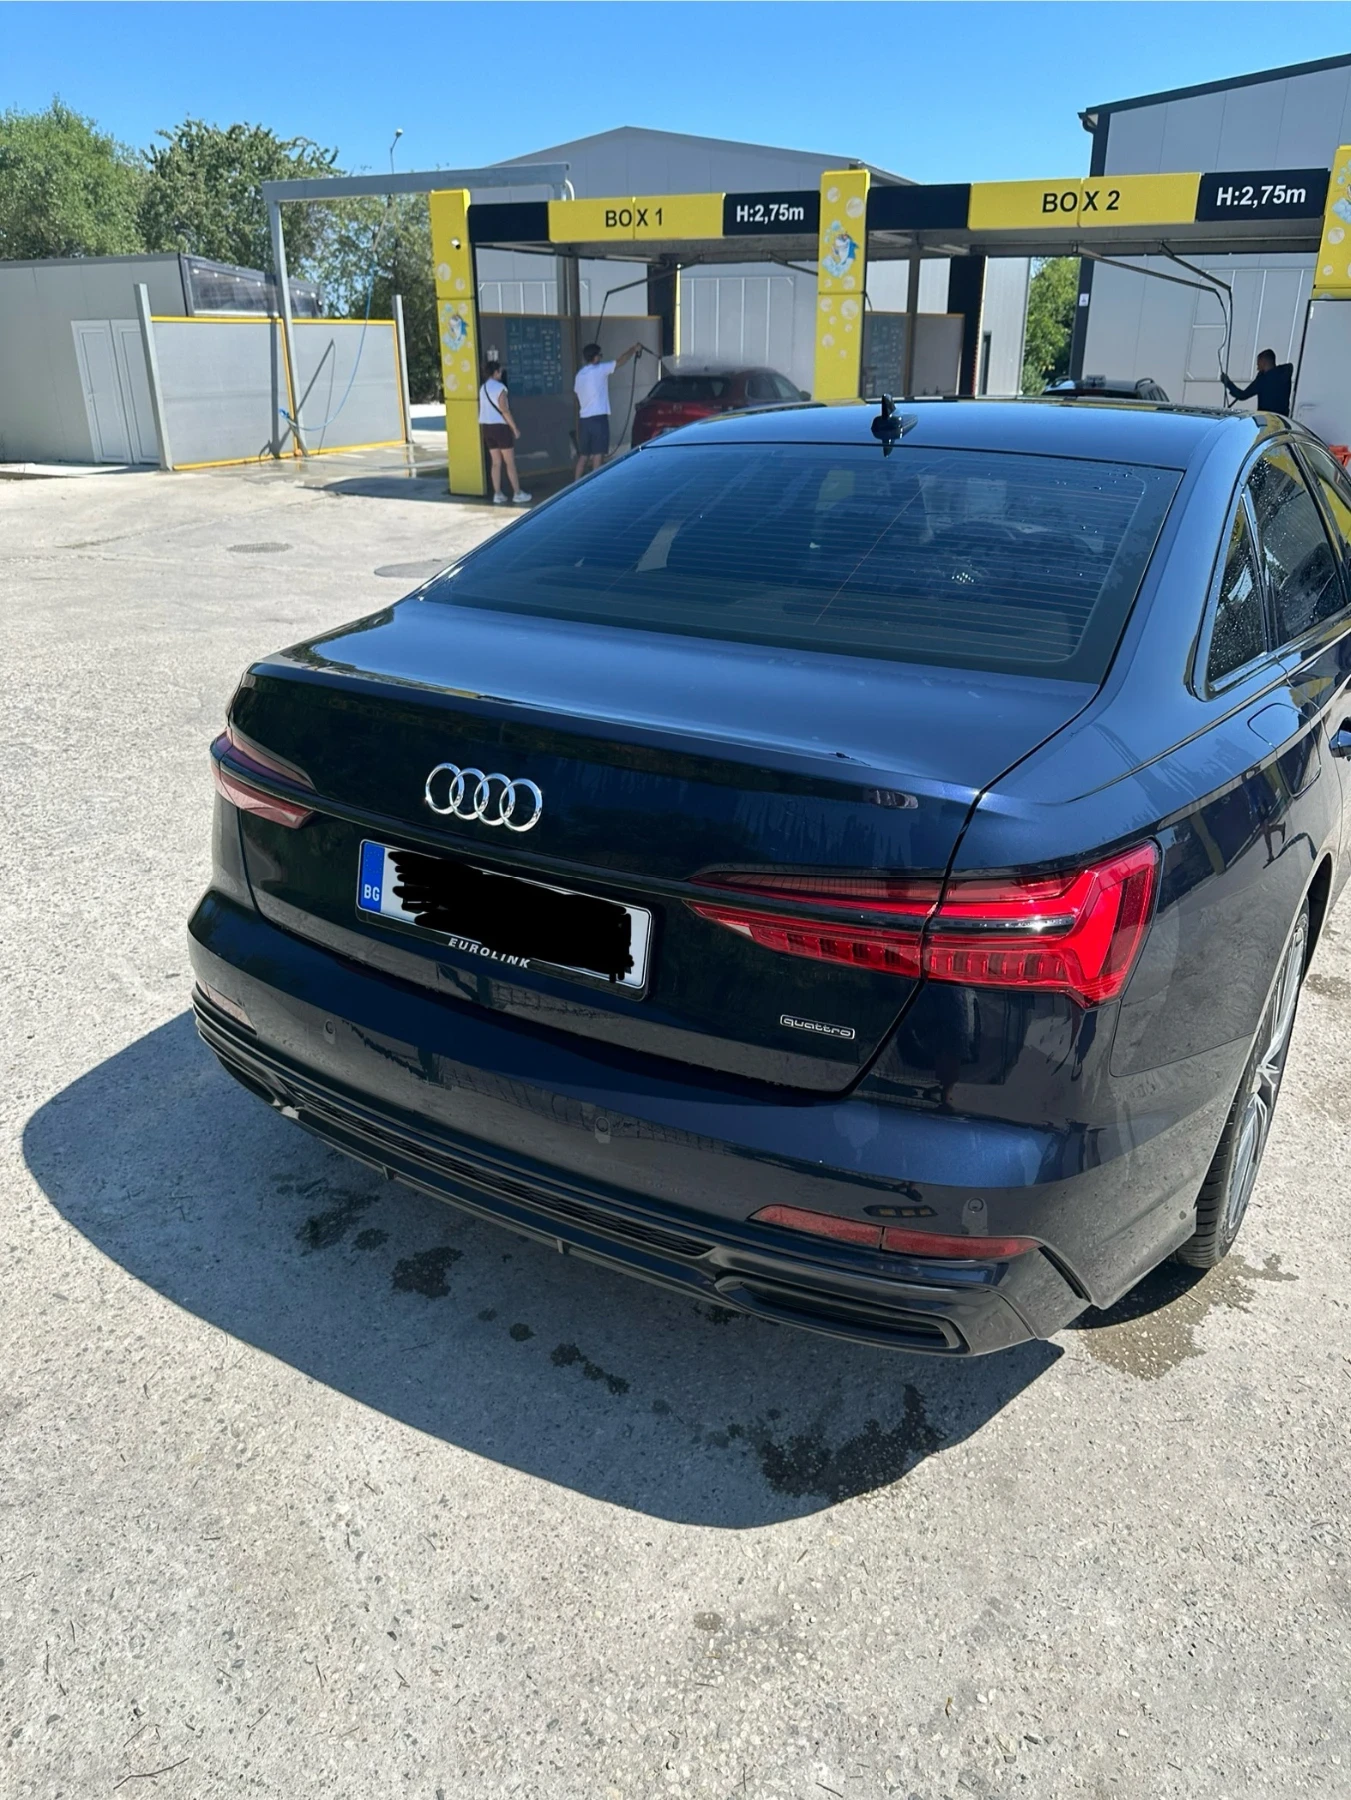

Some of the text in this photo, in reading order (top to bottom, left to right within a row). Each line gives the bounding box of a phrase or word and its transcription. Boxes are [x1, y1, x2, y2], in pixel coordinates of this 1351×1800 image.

[1042, 190, 1121, 213] BOX 2
[1216, 184, 1307, 208] H:2,75m
[605, 207, 663, 228] BOX 1
[736, 204, 804, 225] H:2,75m
[363, 883, 380, 901] BG
[448, 937, 531, 969] EUROLINK
[783, 1017, 851, 1037] quattro
